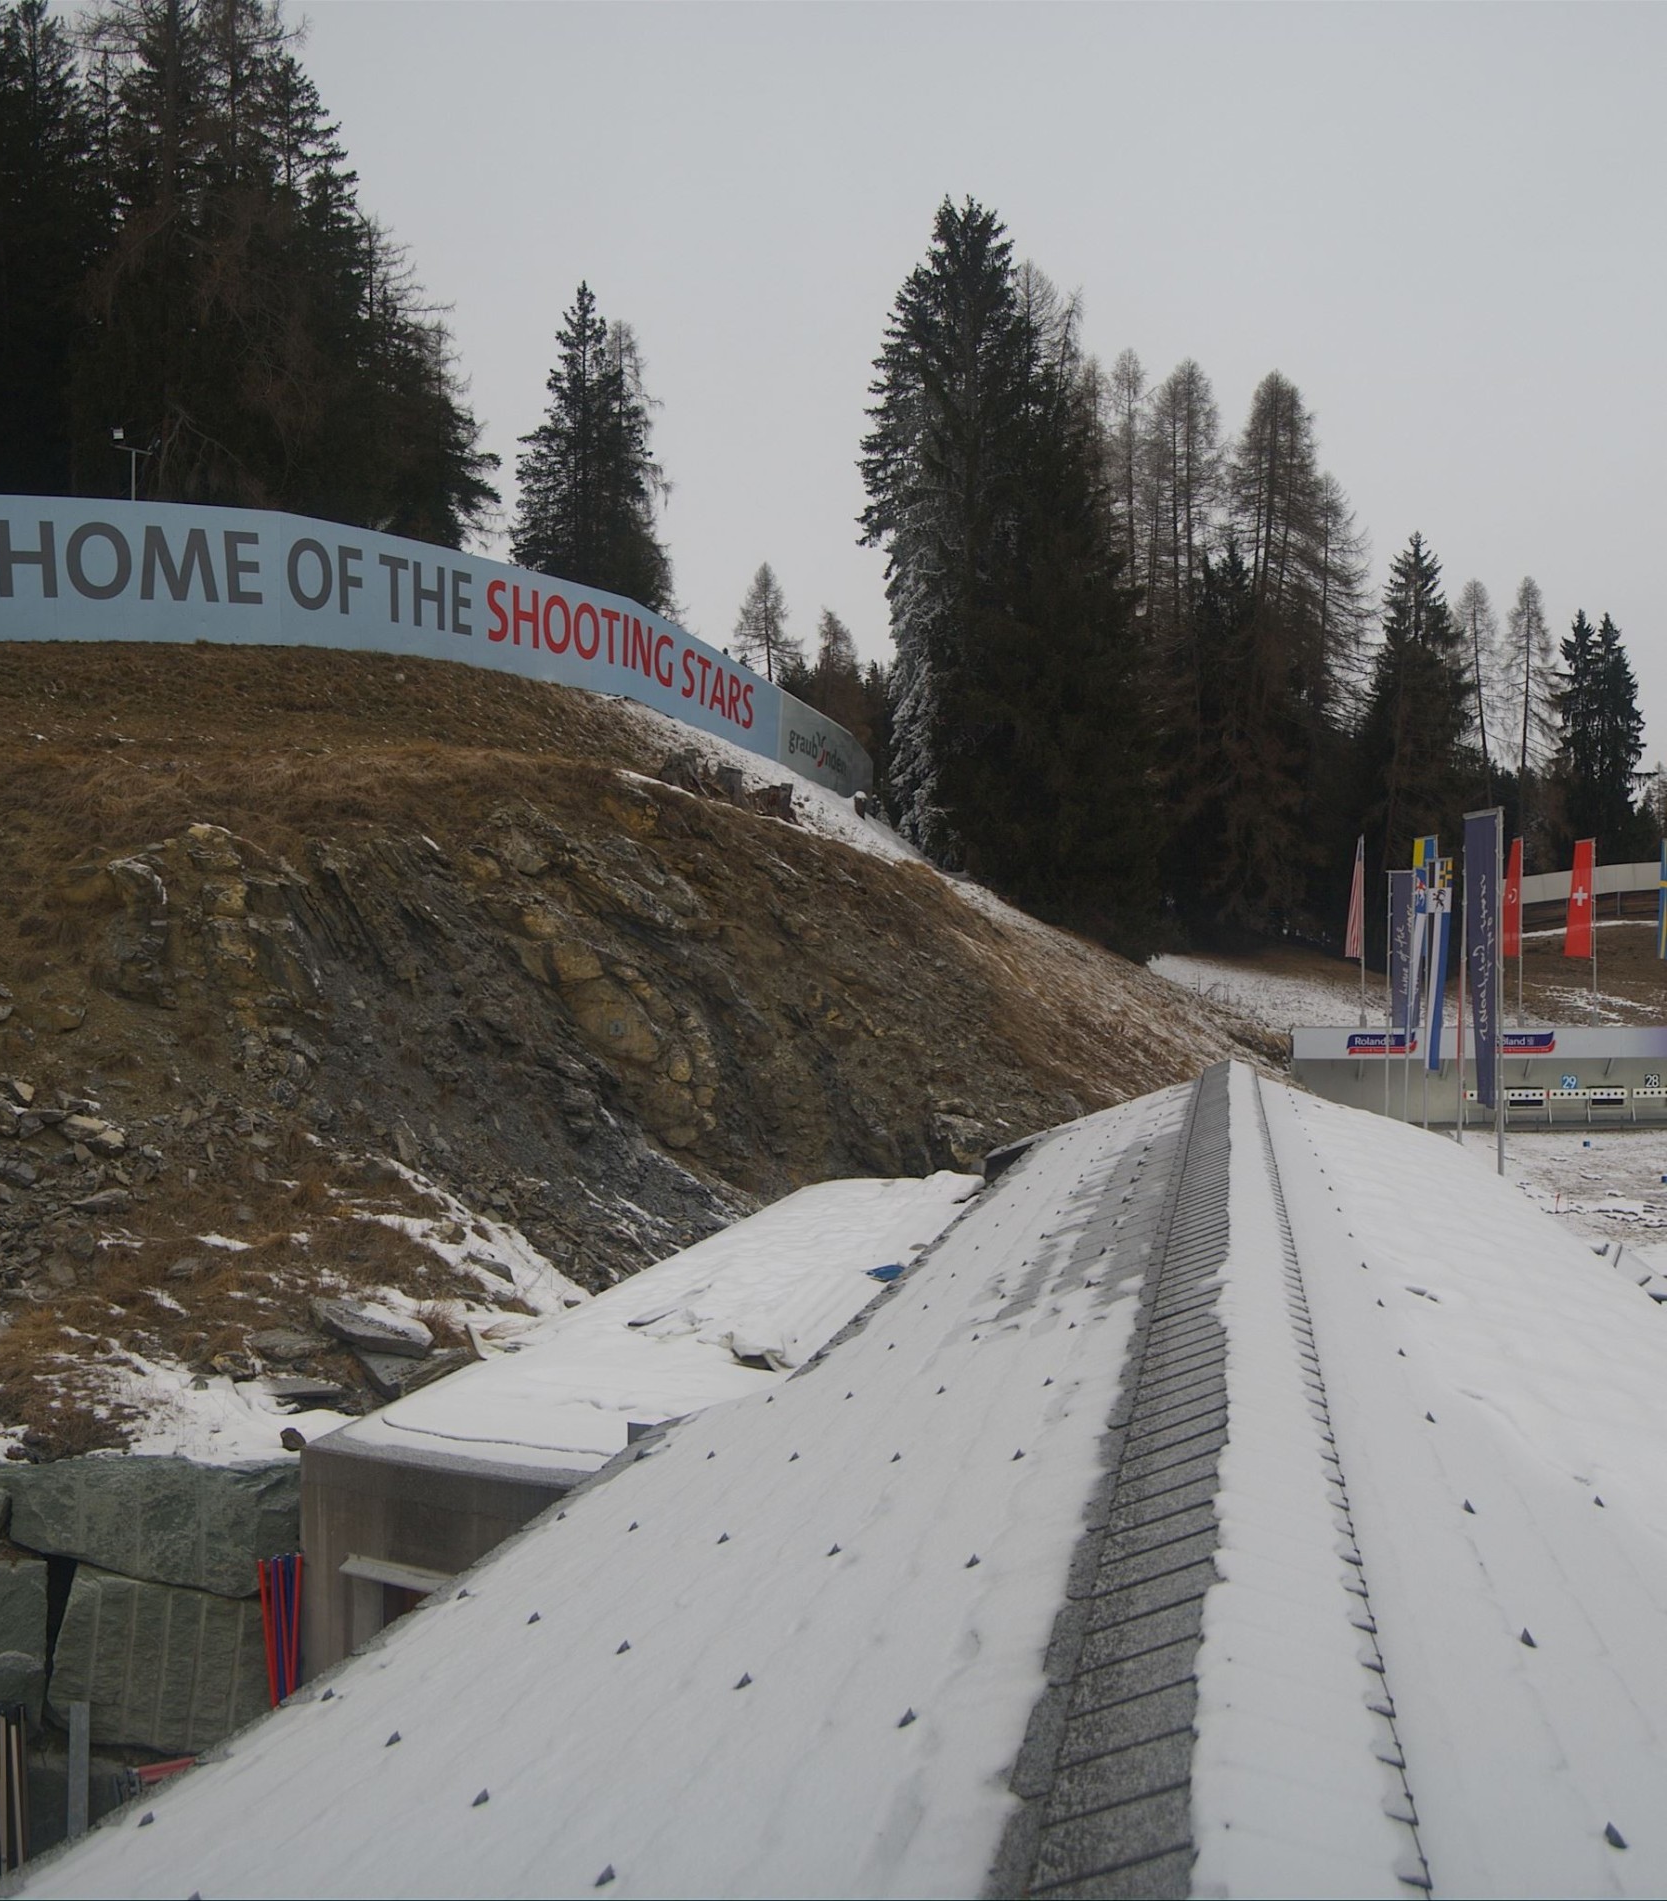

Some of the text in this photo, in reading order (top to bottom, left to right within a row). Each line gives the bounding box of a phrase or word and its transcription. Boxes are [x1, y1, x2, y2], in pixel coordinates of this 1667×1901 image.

[287, 537, 363, 614] OF
[378, 553, 472, 635] THE
[486, 579, 674, 687] SHOOTING
[681, 648, 754, 729] STARS
[1355, 1036, 1386, 1045] Roland
[1563, 1075, 1576, 1088] 29
[1646, 1075, 1659, 1087] 28
